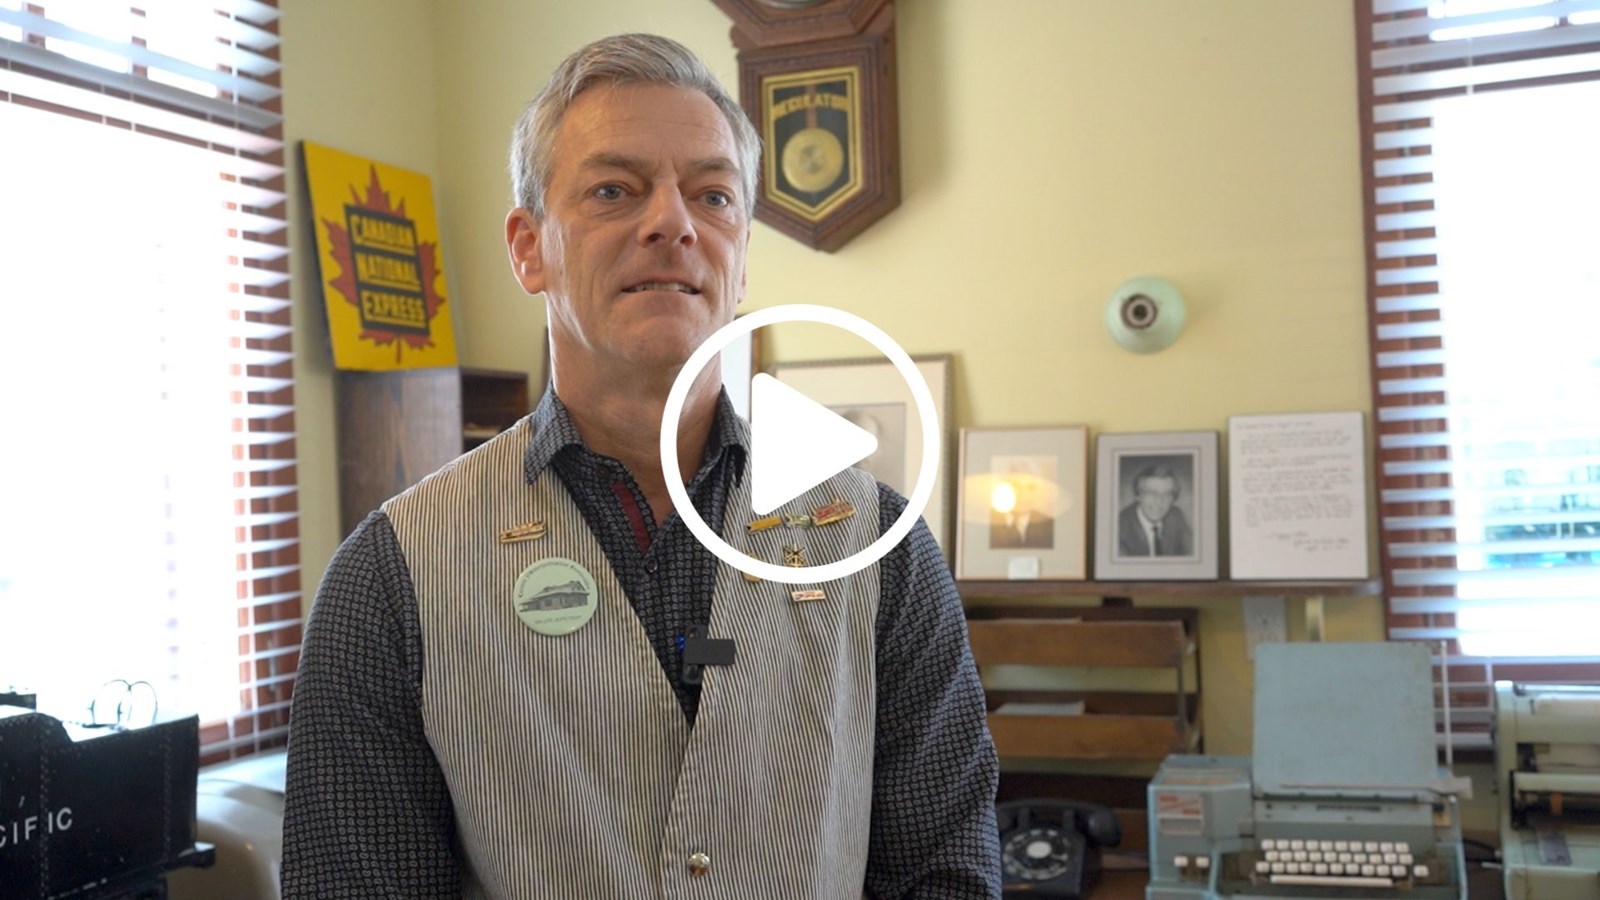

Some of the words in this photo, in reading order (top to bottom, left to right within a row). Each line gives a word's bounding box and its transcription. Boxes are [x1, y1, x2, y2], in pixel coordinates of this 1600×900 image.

[350, 214, 415, 255] CANADIAN
[355, 252, 421, 290] NATIONAL
[361, 290, 426, 326] EXPRESS
